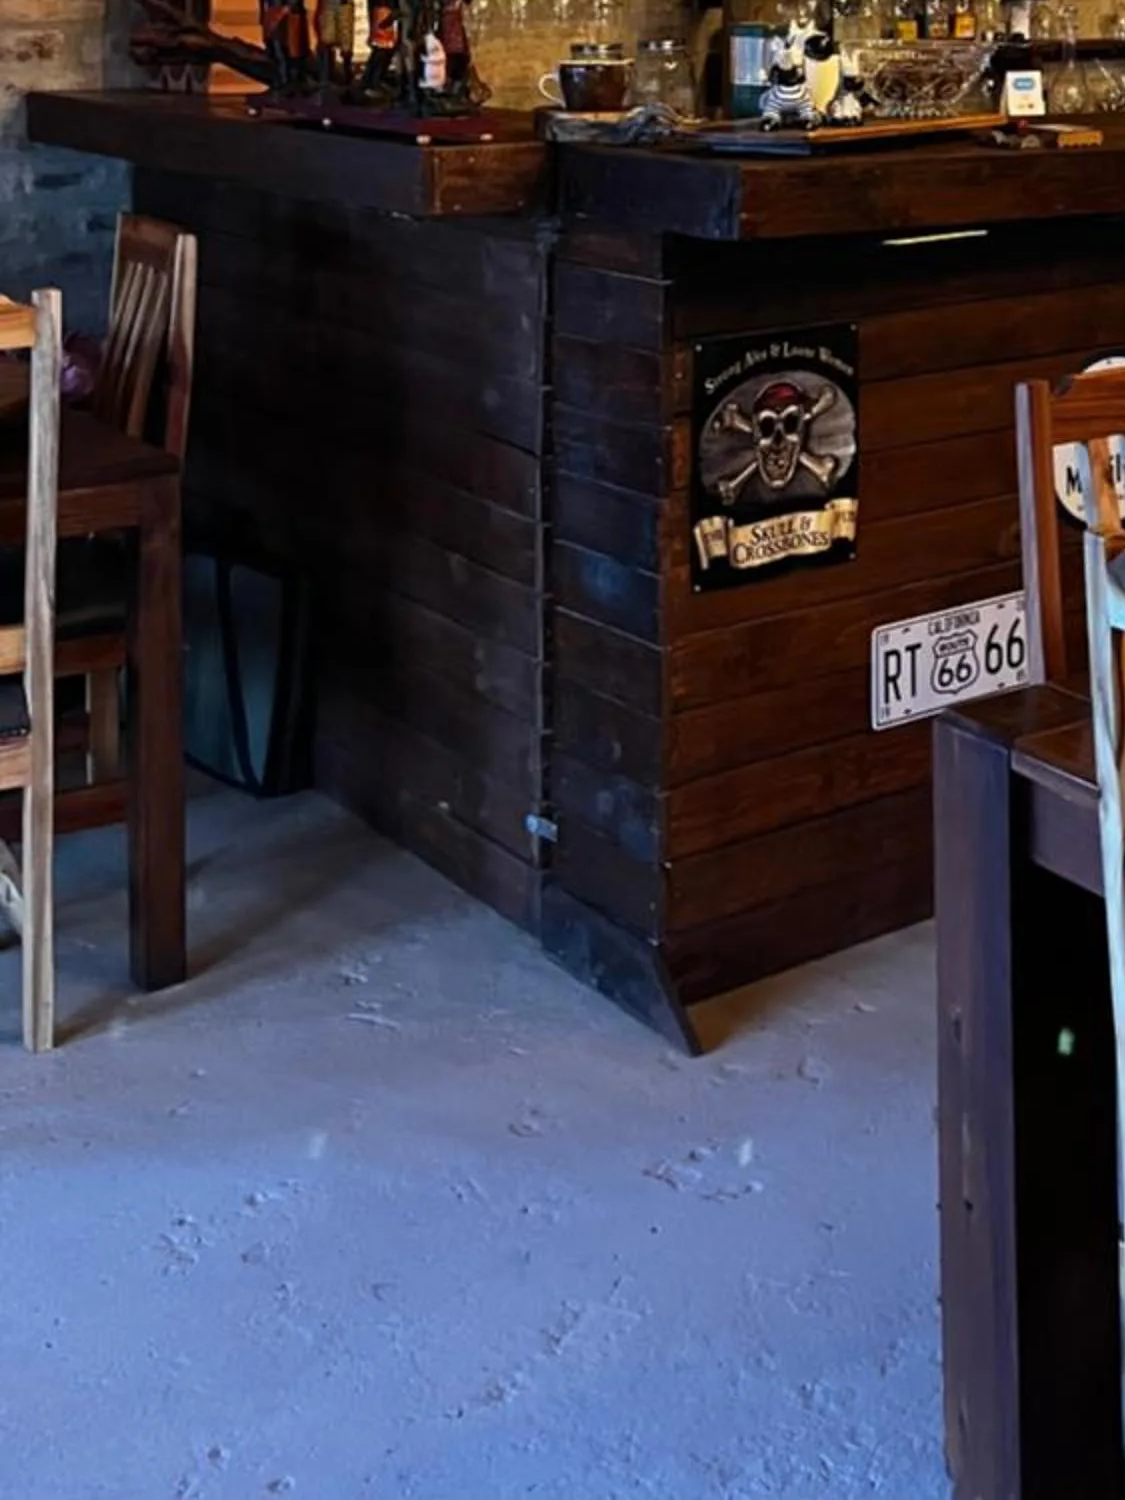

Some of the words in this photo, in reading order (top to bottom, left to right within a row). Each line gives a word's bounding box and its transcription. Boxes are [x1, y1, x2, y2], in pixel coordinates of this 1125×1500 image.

[884, 642, 922, 704] RT
[984, 617, 1025, 675] 66
[938, 654, 973, 687] 66
